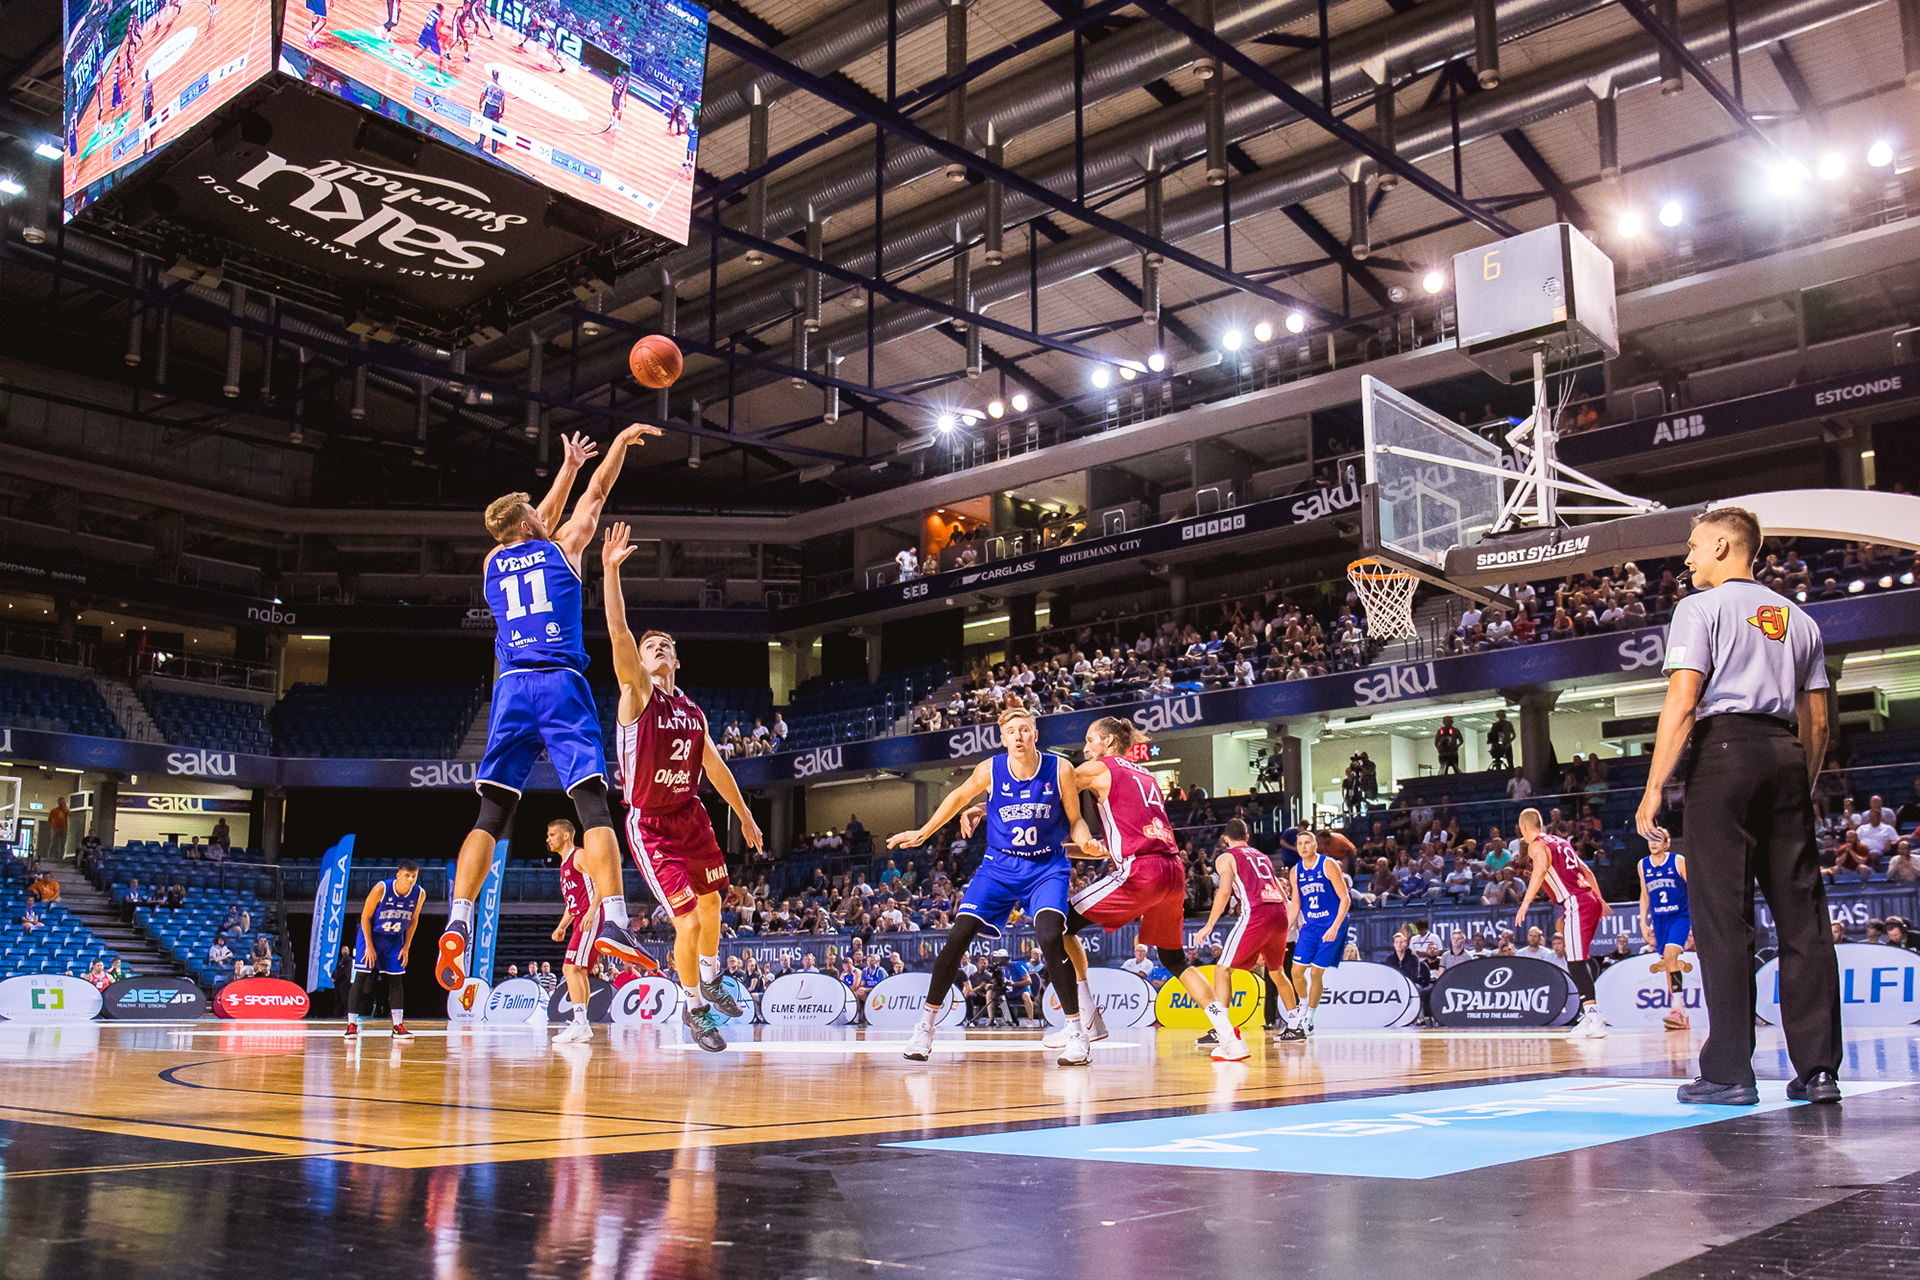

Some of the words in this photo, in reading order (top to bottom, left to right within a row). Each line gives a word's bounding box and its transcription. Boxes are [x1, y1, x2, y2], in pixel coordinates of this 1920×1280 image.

[197, 174, 260, 213] KODU
[236, 150, 506, 269] saku
[266, 216, 385, 269] ELAMUSTE
[398, 266, 475, 282] HEADE
[1483, 250, 1501, 281] 6
[1815, 377, 1902, 406] ESTCONDE
[1653, 414, 1706, 445] ABB
[1291, 486, 1361, 525] saku
[1184, 516, 1244, 538] CRAMO
[495, 550, 547, 573] VENE
[1059, 545, 1118, 565] ROTERMANN
[1118, 539, 1142, 554] CITY
[980, 560, 1036, 583] CARGLASS
[499, 568, 554, 622] 11
[902, 583, 930, 600] SEB
[248, 605, 296, 625] naba
[1619, 631, 1665, 671] sa
[1354, 660, 1438, 707] saku
[1132, 695, 1202, 736] saku
[670, 738, 692, 761] 28
[166, 749, 237, 776] saku
[409, 760, 476, 788] saku
[793, 746, 844, 779] saku
[147, 796, 204, 812] saku
[1011, 826, 1038, 847] 20
[1246, 856, 1273, 880] 15
[1308, 895, 1319, 909] 21
[1658, 890, 1669, 904] 2
[323, 853, 348, 978] ALEXELA
[381, 921, 402, 933] 44
[244, 994, 305, 1006] SPORTLAND
[502, 994, 535, 1009] Tallinn
[623, 984, 665, 1020] G4S
[770, 1003, 796, 1014] ELME
[797, 1003, 834, 1014] METALL
[1318, 988, 1403, 1005] ŠKODA
[1636, 988, 1701, 1010] sau
